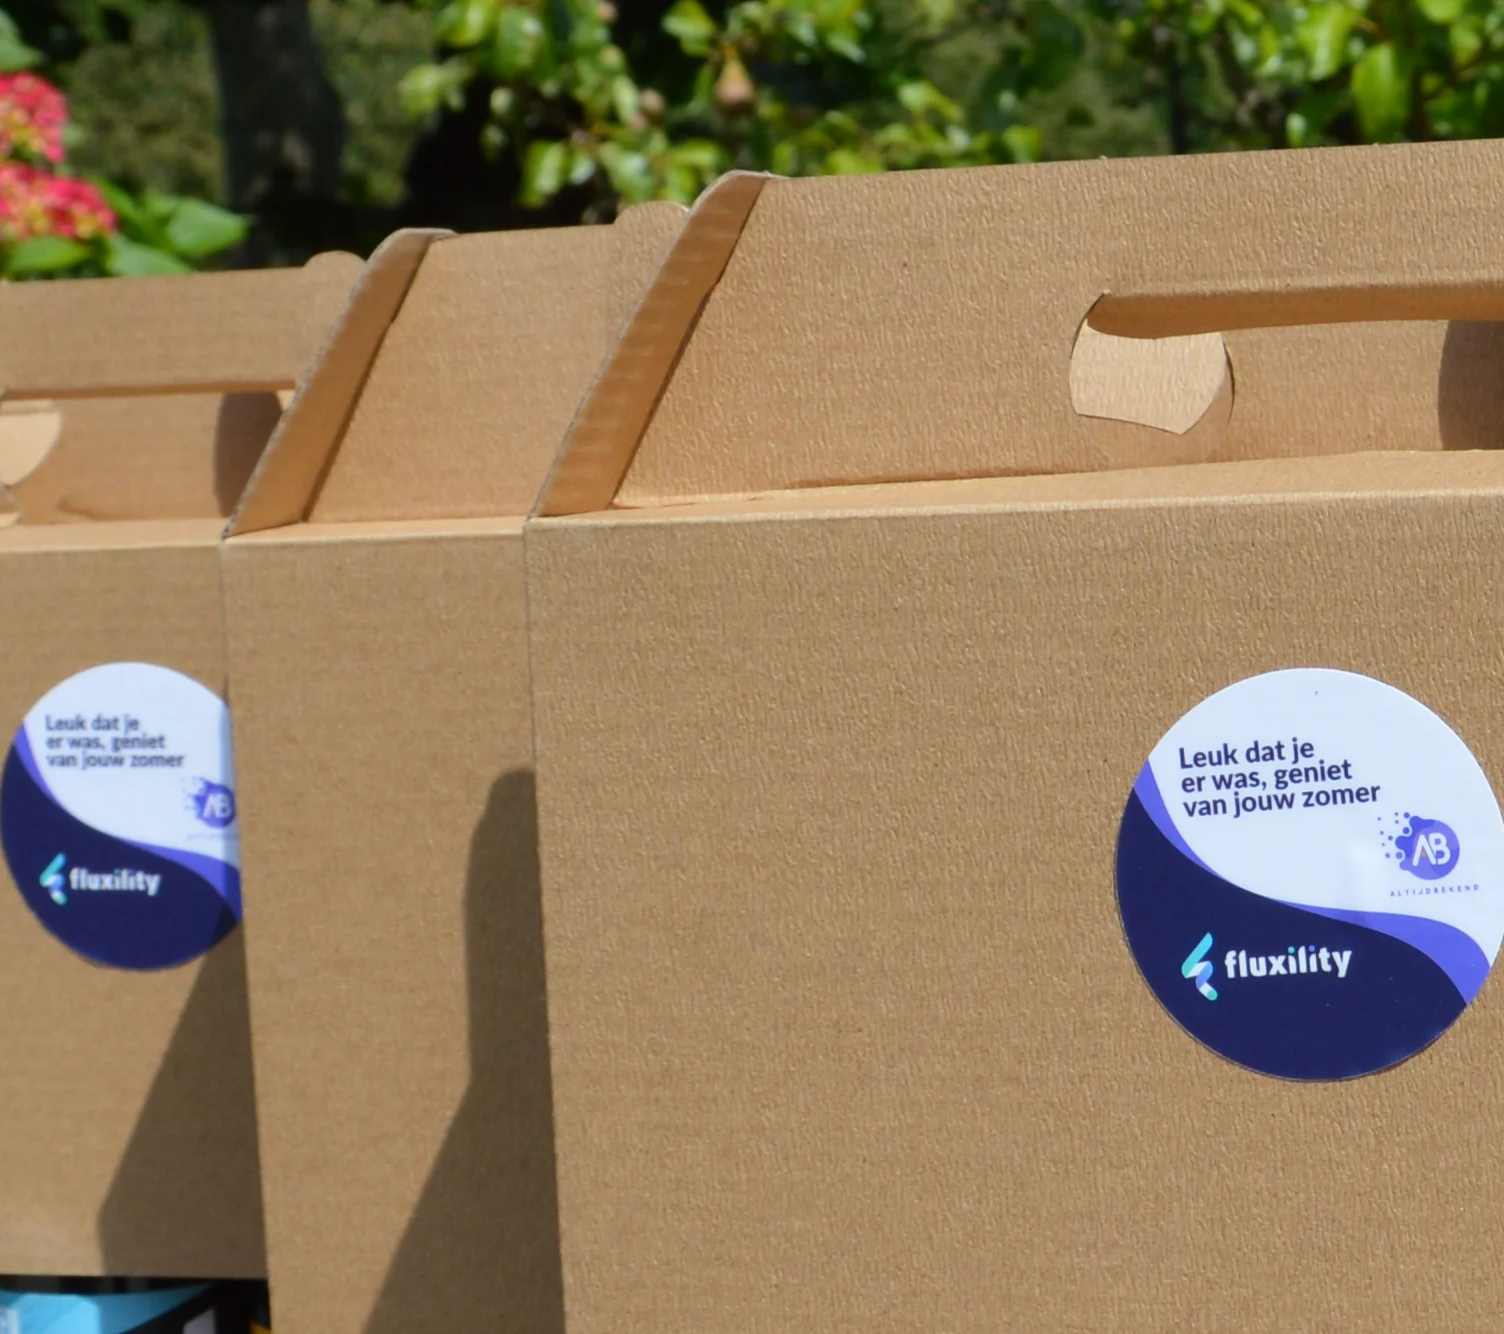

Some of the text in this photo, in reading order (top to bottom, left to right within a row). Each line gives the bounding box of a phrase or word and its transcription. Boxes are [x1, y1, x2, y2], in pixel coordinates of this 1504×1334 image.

[45, 714, 140, 735] Leuk dat je
[45, 734, 64, 749] er
[111, 733, 165, 754] geniet
[1179, 736, 1315, 769] Leuk dat je
[46, 751, 184, 770] van jouw zomer
[1180, 757, 1353, 793] er was, geniet
[1183, 783, 1382, 819] van jouw zomer
[1412, 831, 1452, 867] AB
[68, 867, 162, 896] fluxility
[1224, 944, 1353, 980] fluxility
